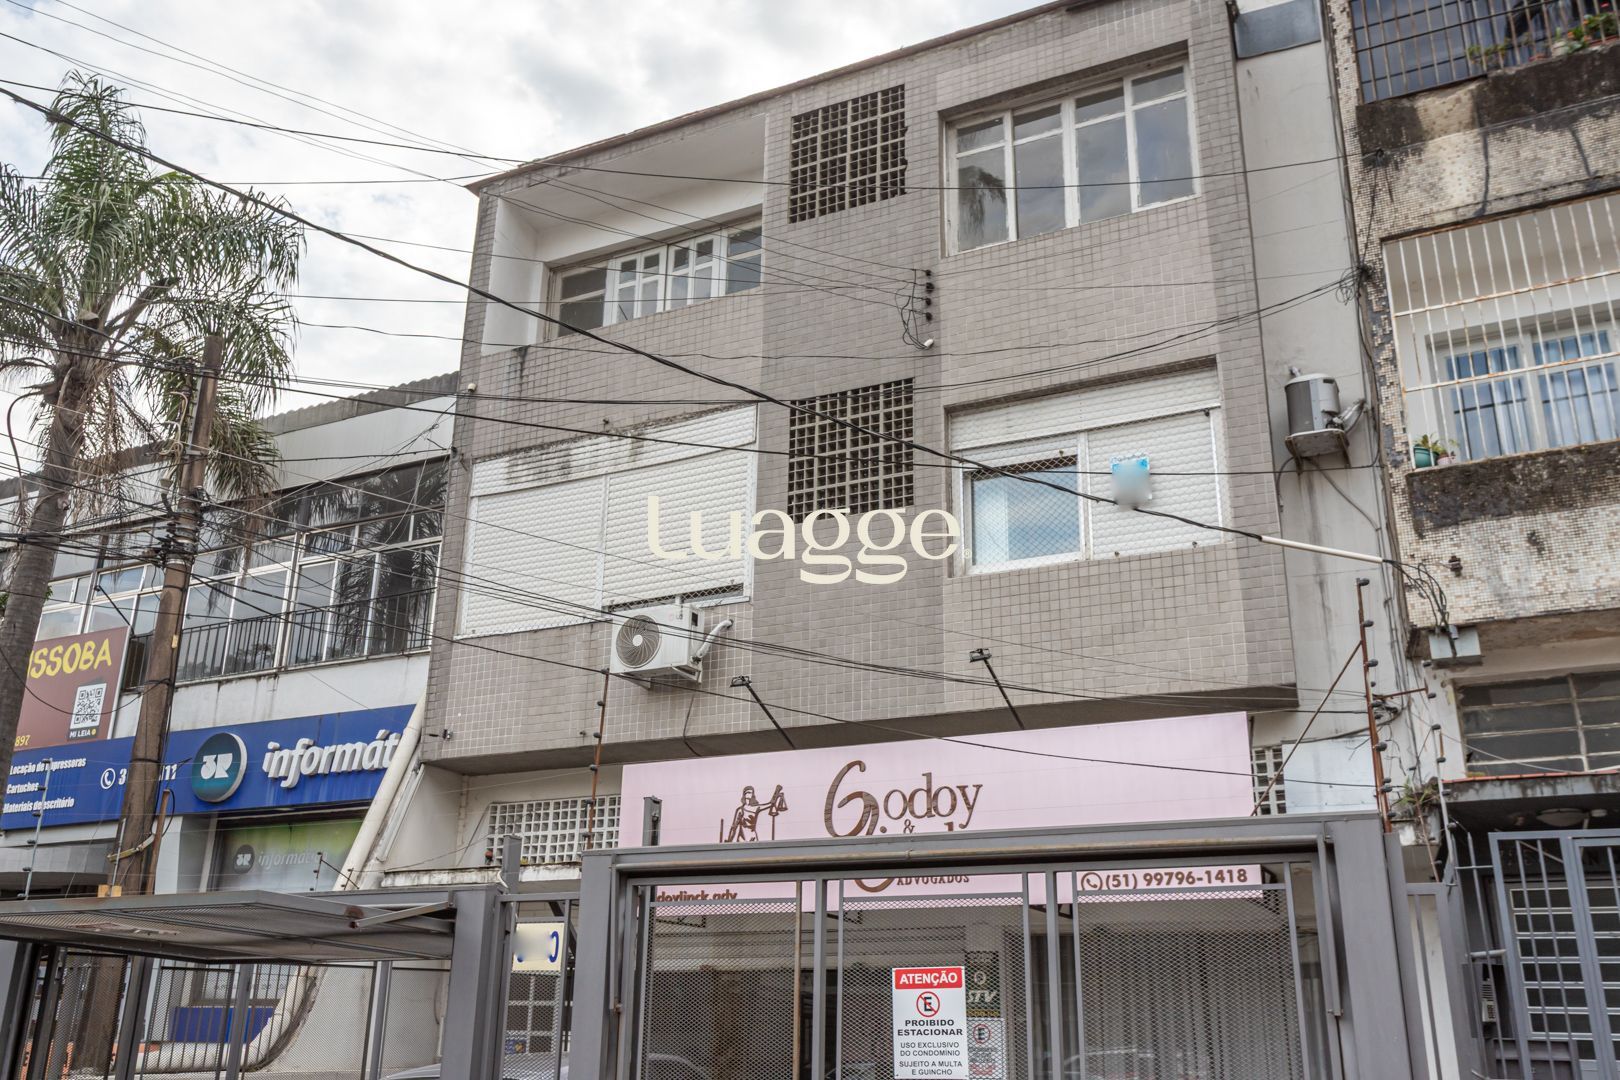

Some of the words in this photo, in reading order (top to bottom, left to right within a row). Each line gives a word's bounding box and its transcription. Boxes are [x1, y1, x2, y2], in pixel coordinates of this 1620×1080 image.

[78, 729, 91, 737] LEIA
[9, 763, 36, 776] Locação
[36, 761, 45, 772] de
[824, 760, 983, 838] Godoy
[3, 801, 33, 814] Materiais
[33, 801, 42, 810] de
[42, 797, 75, 809] escritório
[896, 875, 970, 886] ADVOGADOS
[1106, 873, 1138, 890] (51)
[1143, 868, 1248, 887] 99796-1418
[900, 970, 958, 986] ATENÇÃO
[905, 1019, 955, 1027] PROIBIDO
[897, 1028, 963, 1036] ESTACIONAR
[917, 1041, 960, 1049] EXCLUSIVO
[899, 1060, 930, 1068] SUJEITO
[931, 1060, 937, 1068] A
[938, 1060, 963, 1068] MULTA
[918, 1068, 953, 1076] GUINCHO
